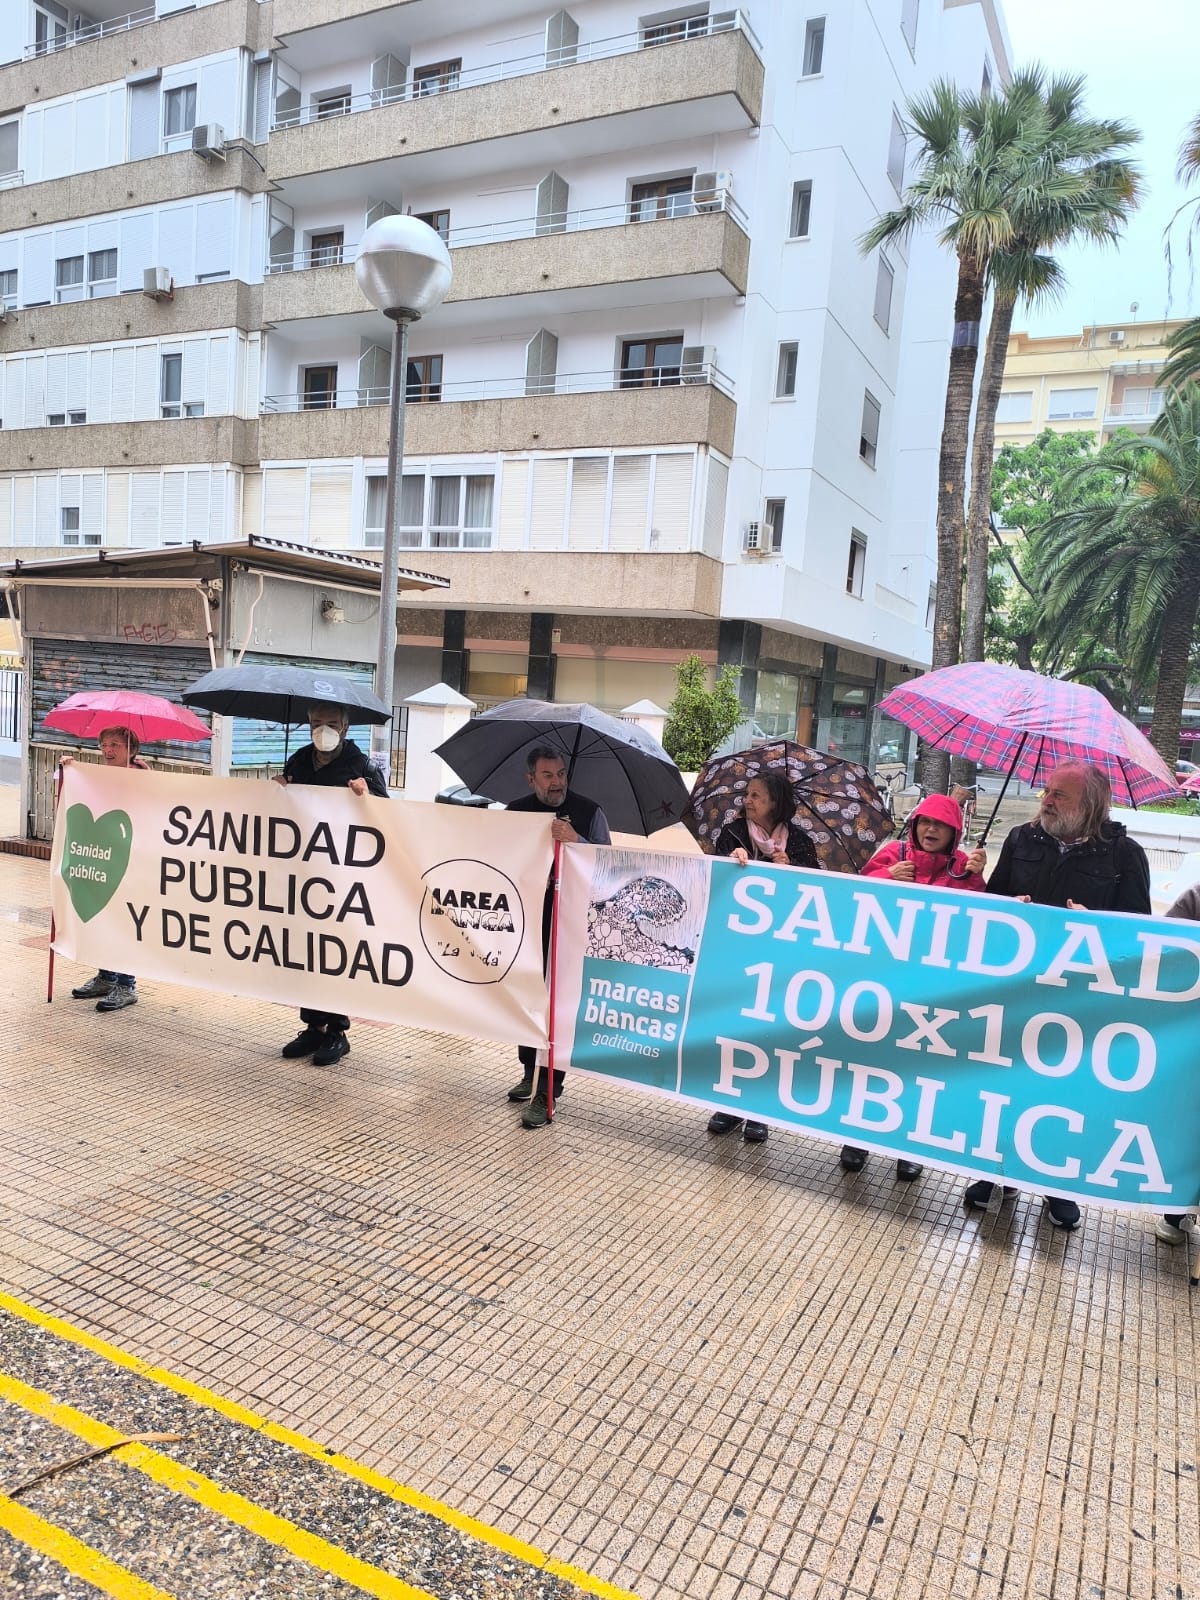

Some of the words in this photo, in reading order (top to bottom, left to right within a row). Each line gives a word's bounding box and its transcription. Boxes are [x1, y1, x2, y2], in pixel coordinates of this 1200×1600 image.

[70, 841, 111, 860] Sanidad
[163, 805, 386, 868] SANIDAD
[69, 864, 107, 883] pública
[160, 856, 376, 926] PÚBLICA
[126, 902, 150, 942] Y
[162, 908, 211, 955] DE
[223, 919, 414, 987] CALIDAD
[728, 875, 1200, 1003] SANIDAD
[584, 998, 678, 1042] blancas
[589, 977, 680, 1014] mareas
[740, 961, 1157, 1092] 100x100
[591, 1032, 660, 1059] gaditanas
[713, 1035, 1173, 1193] PÚBLICA
